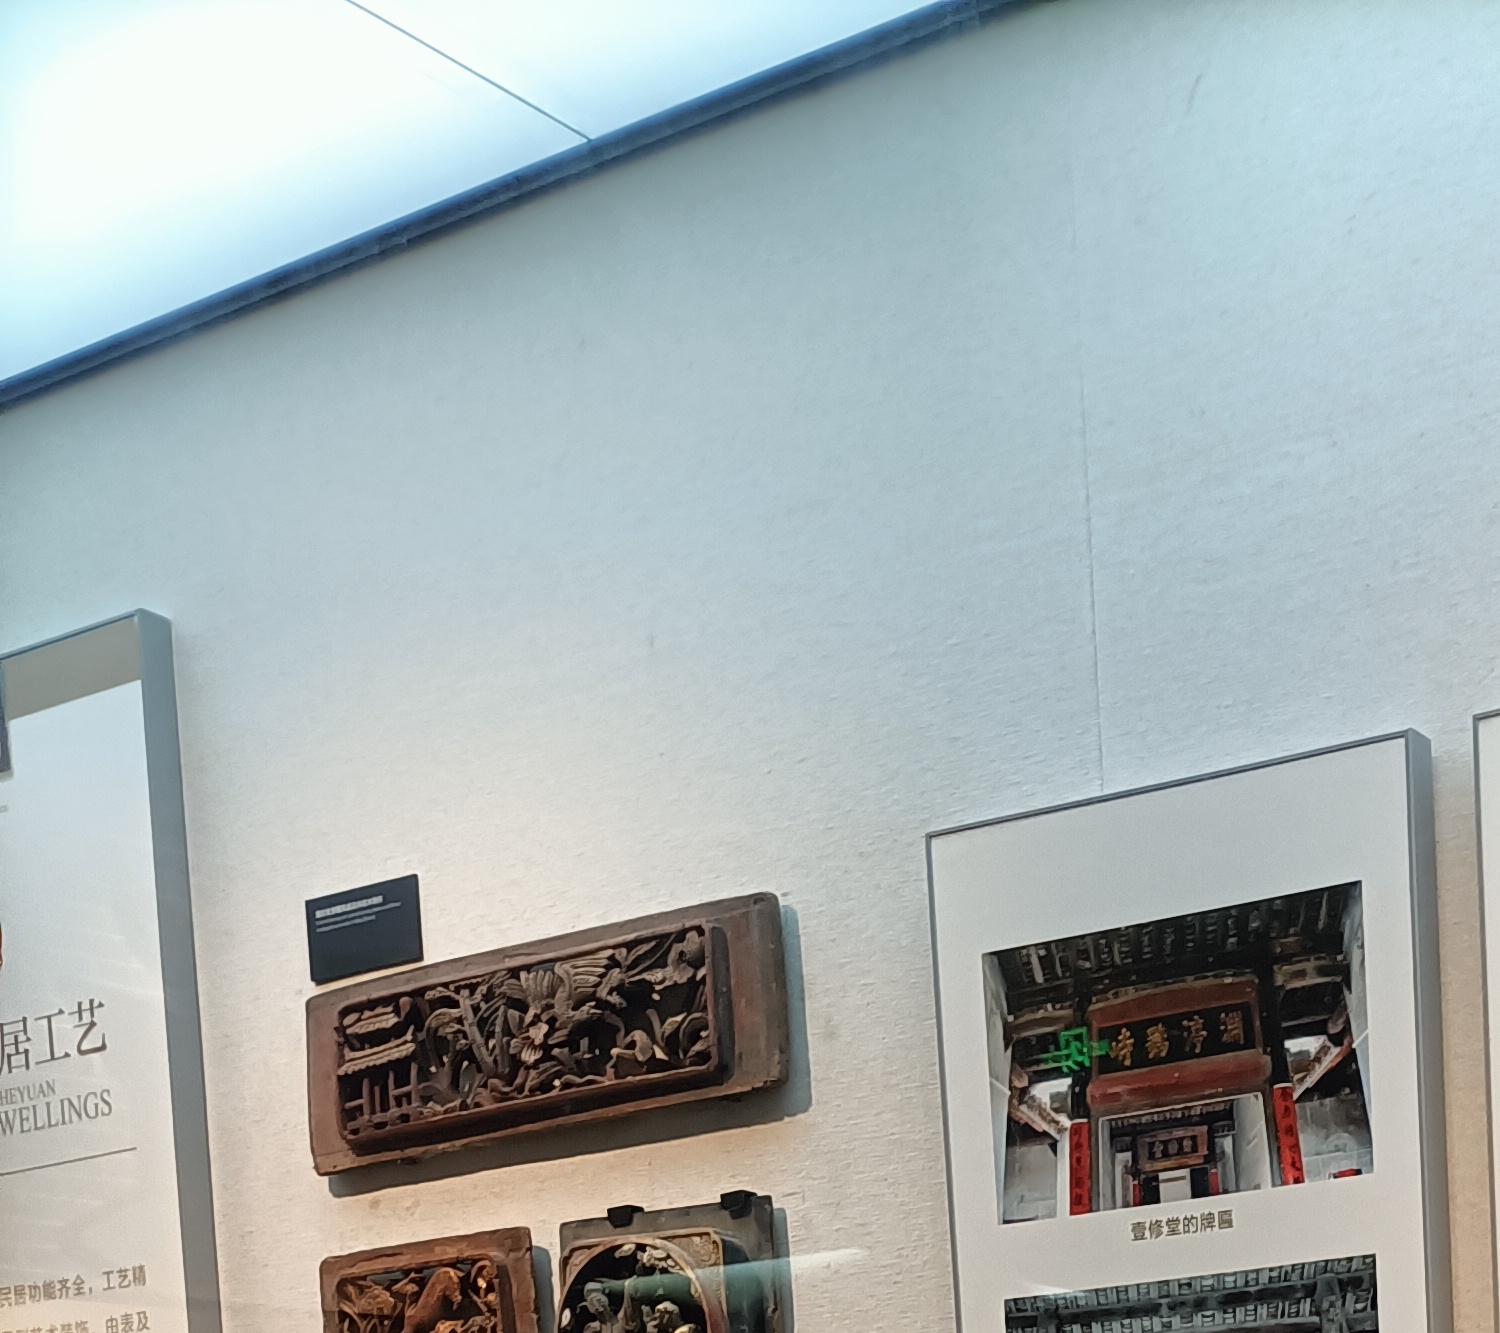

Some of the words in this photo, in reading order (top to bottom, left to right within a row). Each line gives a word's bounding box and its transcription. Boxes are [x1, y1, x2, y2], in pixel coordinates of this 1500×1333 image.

[0, 998, 108, 1076] 居工艺
[0, 1079, 56, 1106] HEYUAN
[1130, 1209, 1234, 1242] 壹修堂的牌匾
